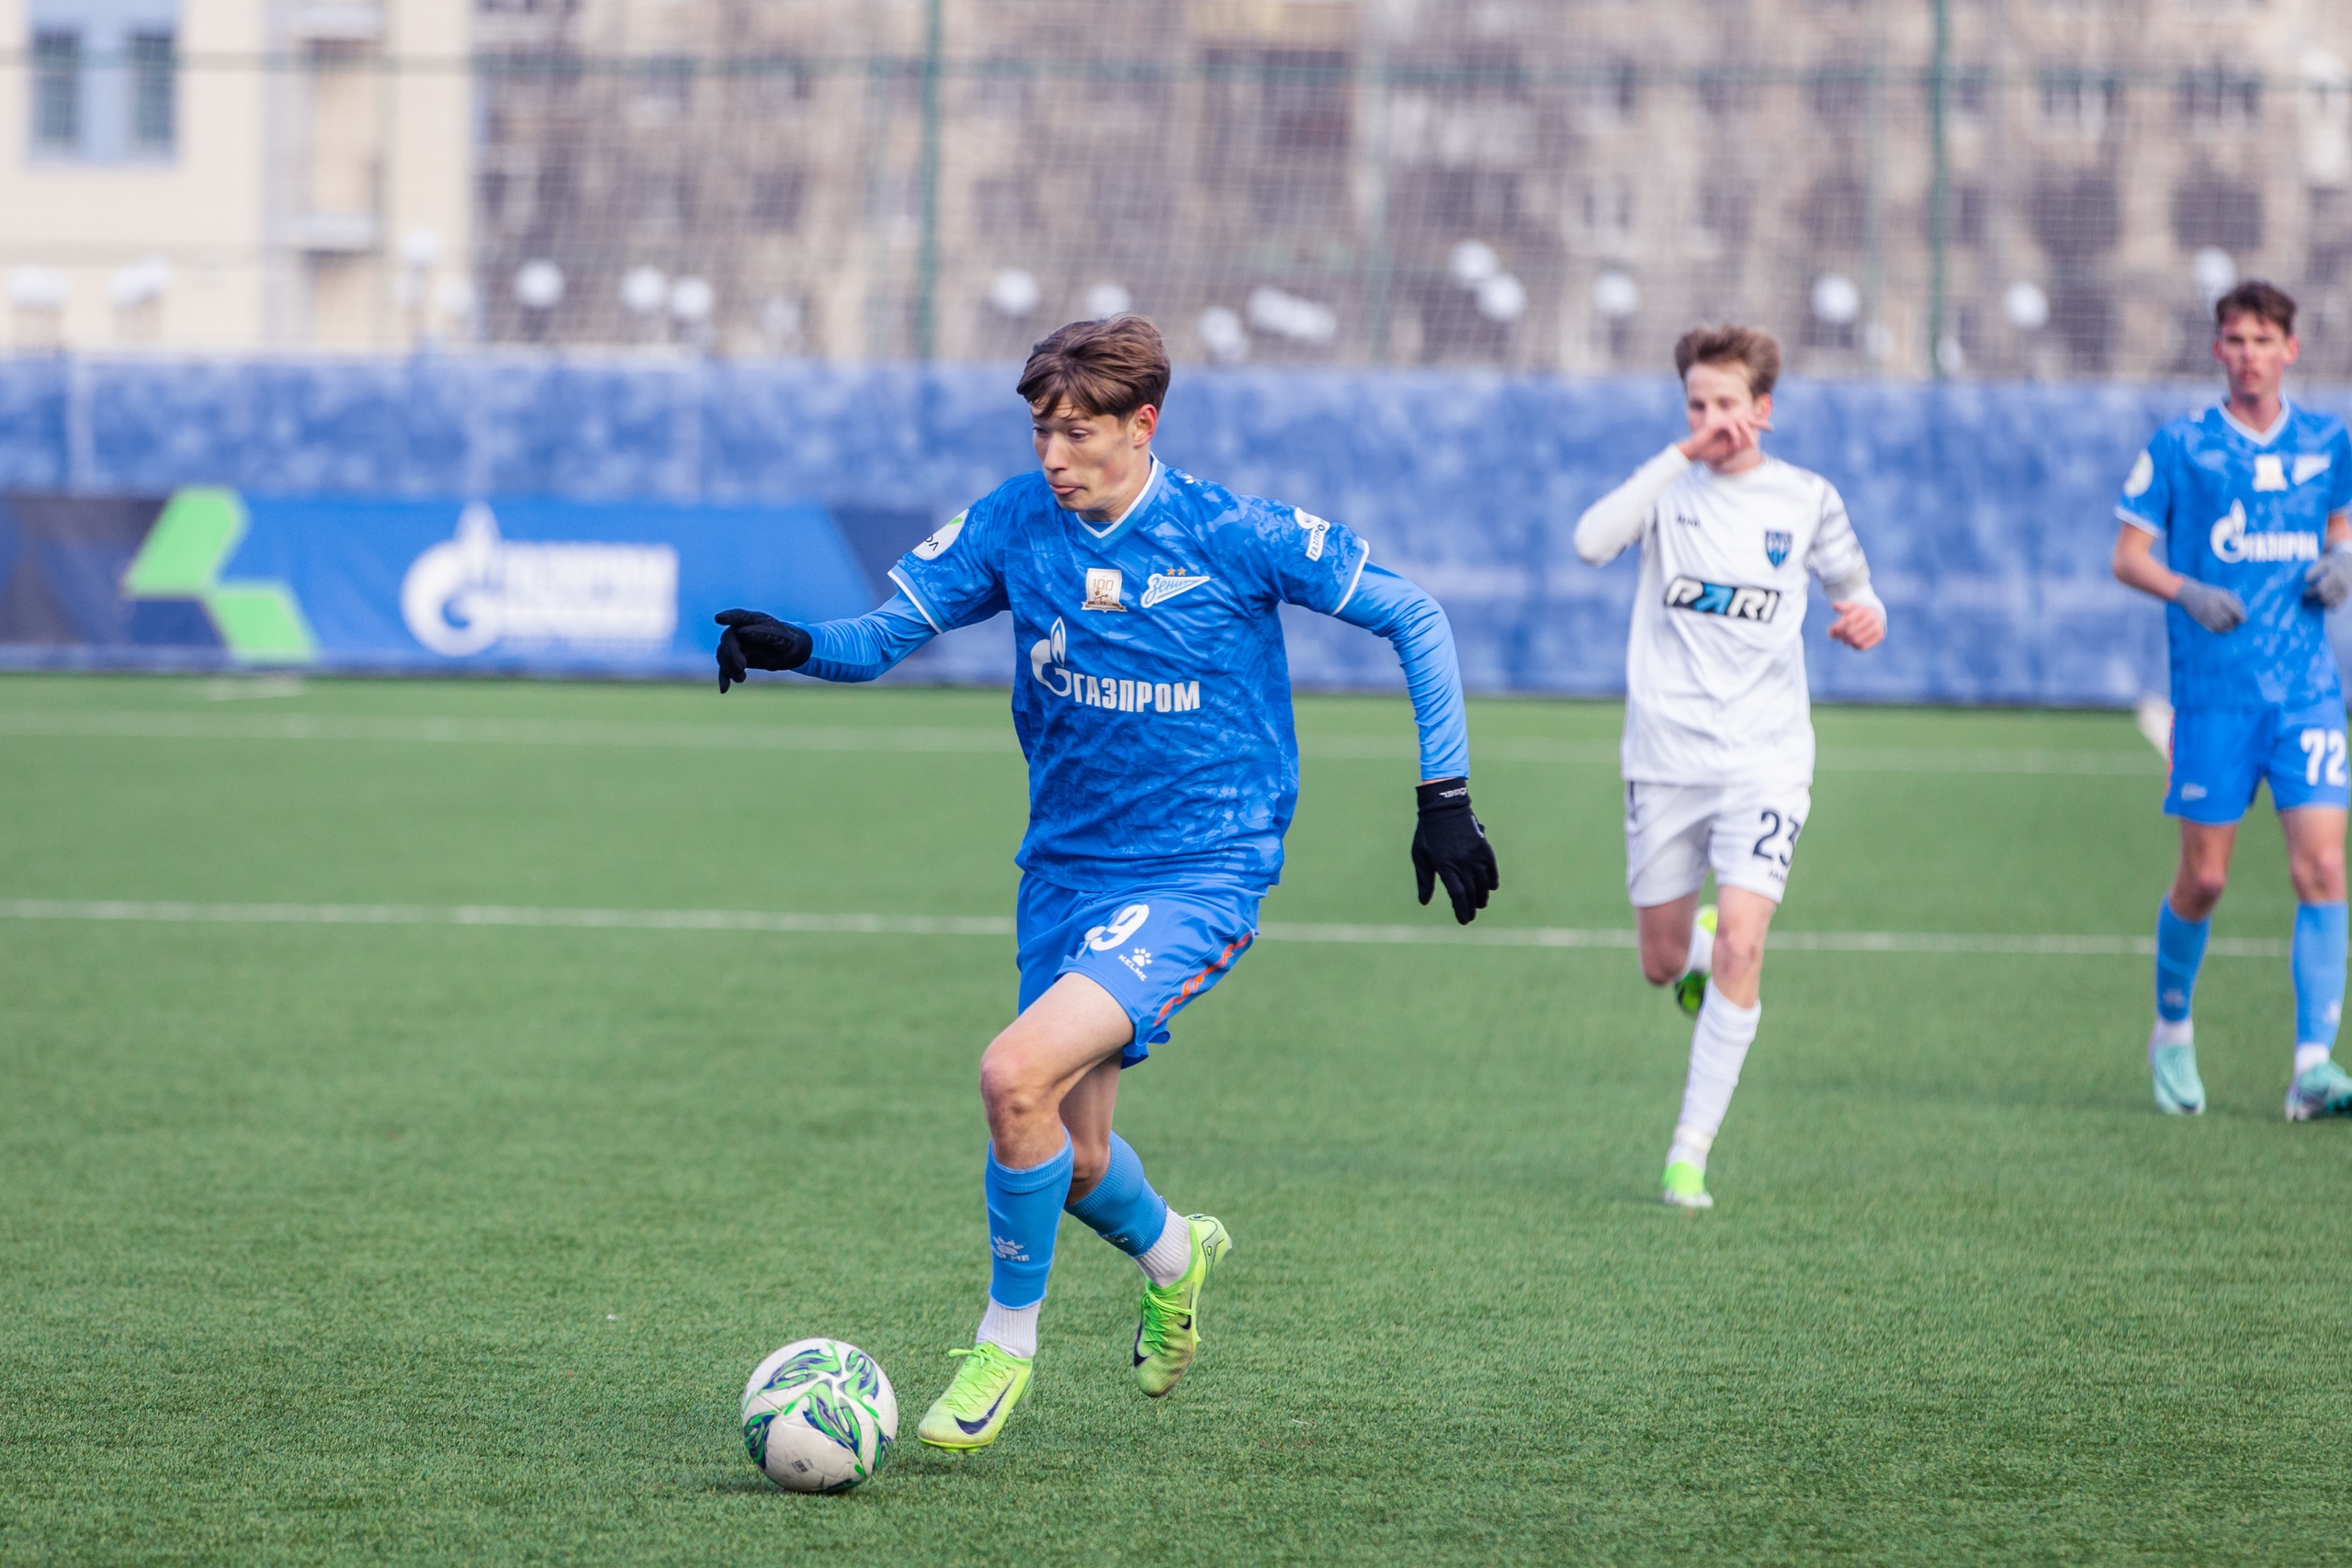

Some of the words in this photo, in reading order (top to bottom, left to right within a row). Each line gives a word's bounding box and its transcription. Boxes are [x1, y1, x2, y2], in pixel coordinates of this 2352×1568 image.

[1093, 579, 1114, 592] 100
[1145, 576, 1202, 604] Зенит
[1666, 577, 1779, 622] PARI
[1073, 672, 1201, 713] ГАЗПРОМ
[2300, 728, 2347, 786] 72
[1752, 811, 1801, 866] 23
[1085, 904, 1150, 952] 9
[1118, 953, 1148, 982] KELME
